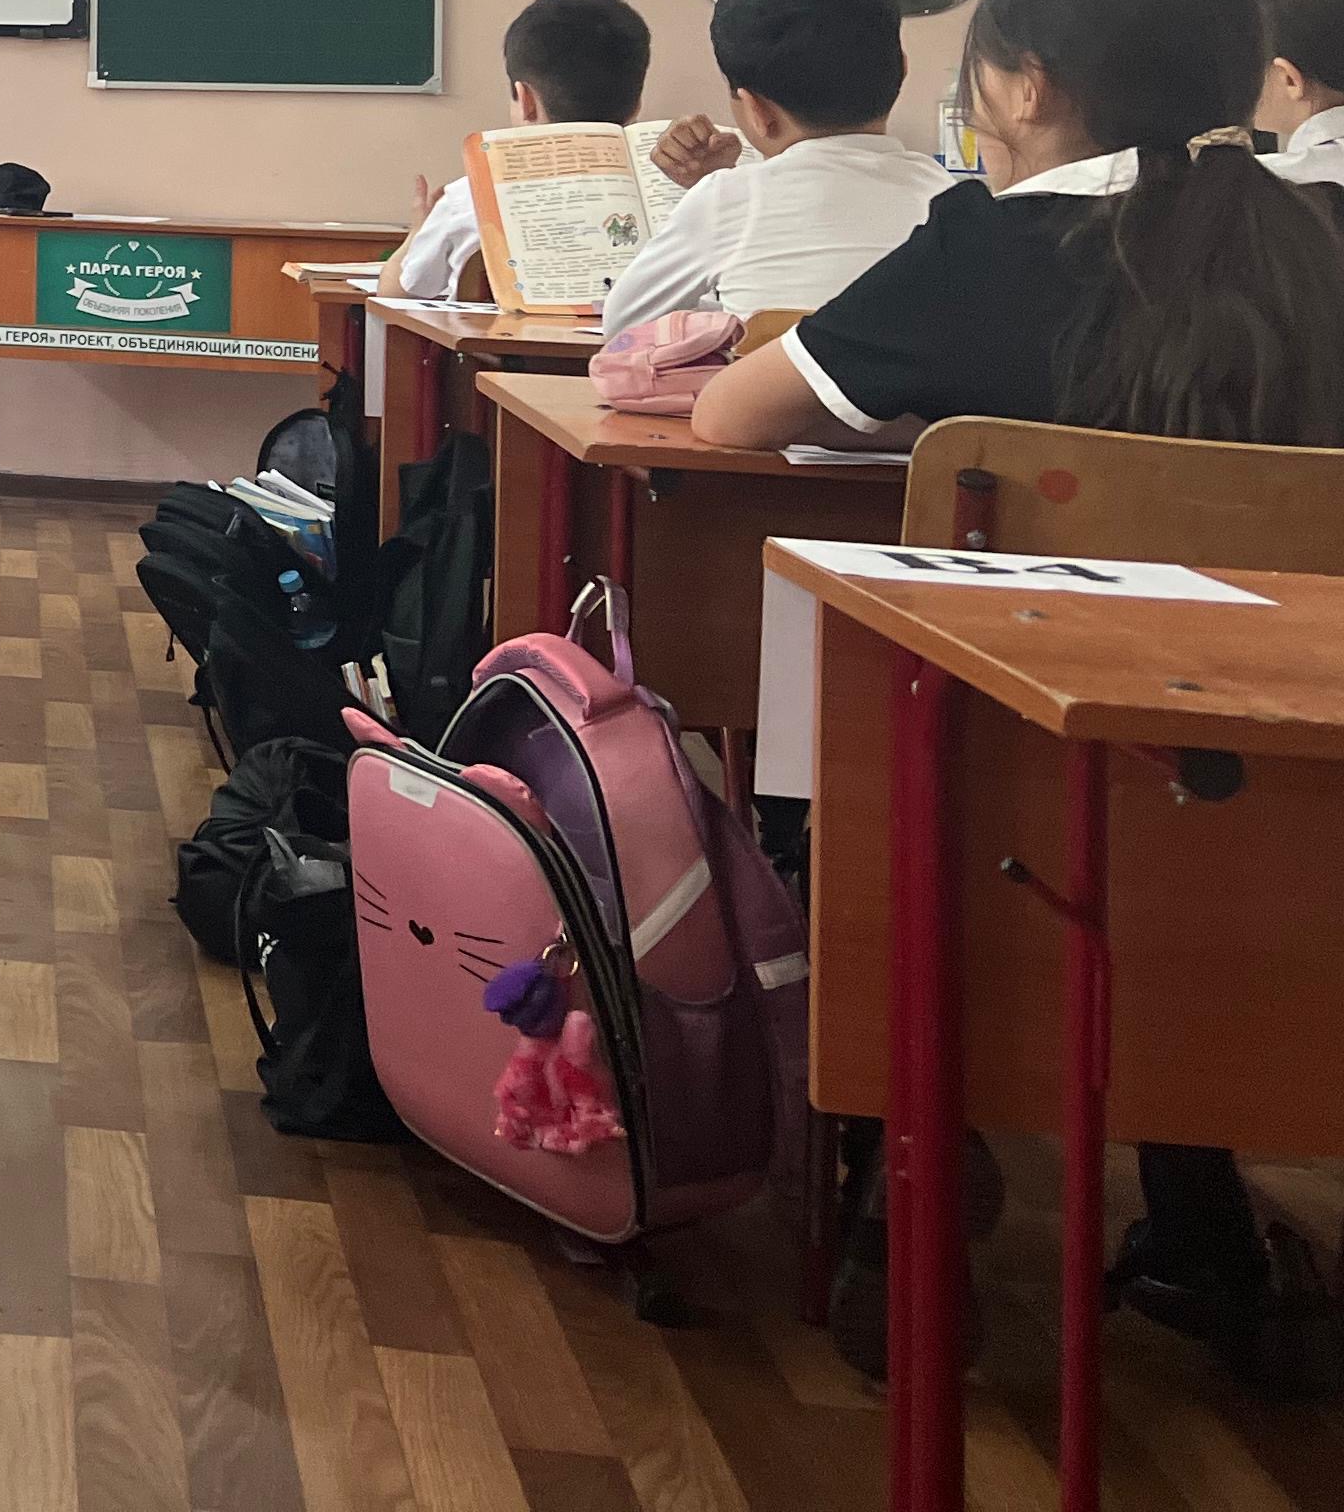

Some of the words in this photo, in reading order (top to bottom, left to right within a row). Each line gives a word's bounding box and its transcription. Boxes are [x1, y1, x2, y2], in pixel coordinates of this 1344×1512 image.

[79, 262, 131, 276] ПАРТА
[136, 266, 186, 279] ГЕРОЯ
[5, 331, 56, 344] ГЕРОЯ»
[59, 333, 115, 349] ПРОЕКТ,
[118, 336, 241, 355] ОБЪЕДИНЯЮЩИЙ
